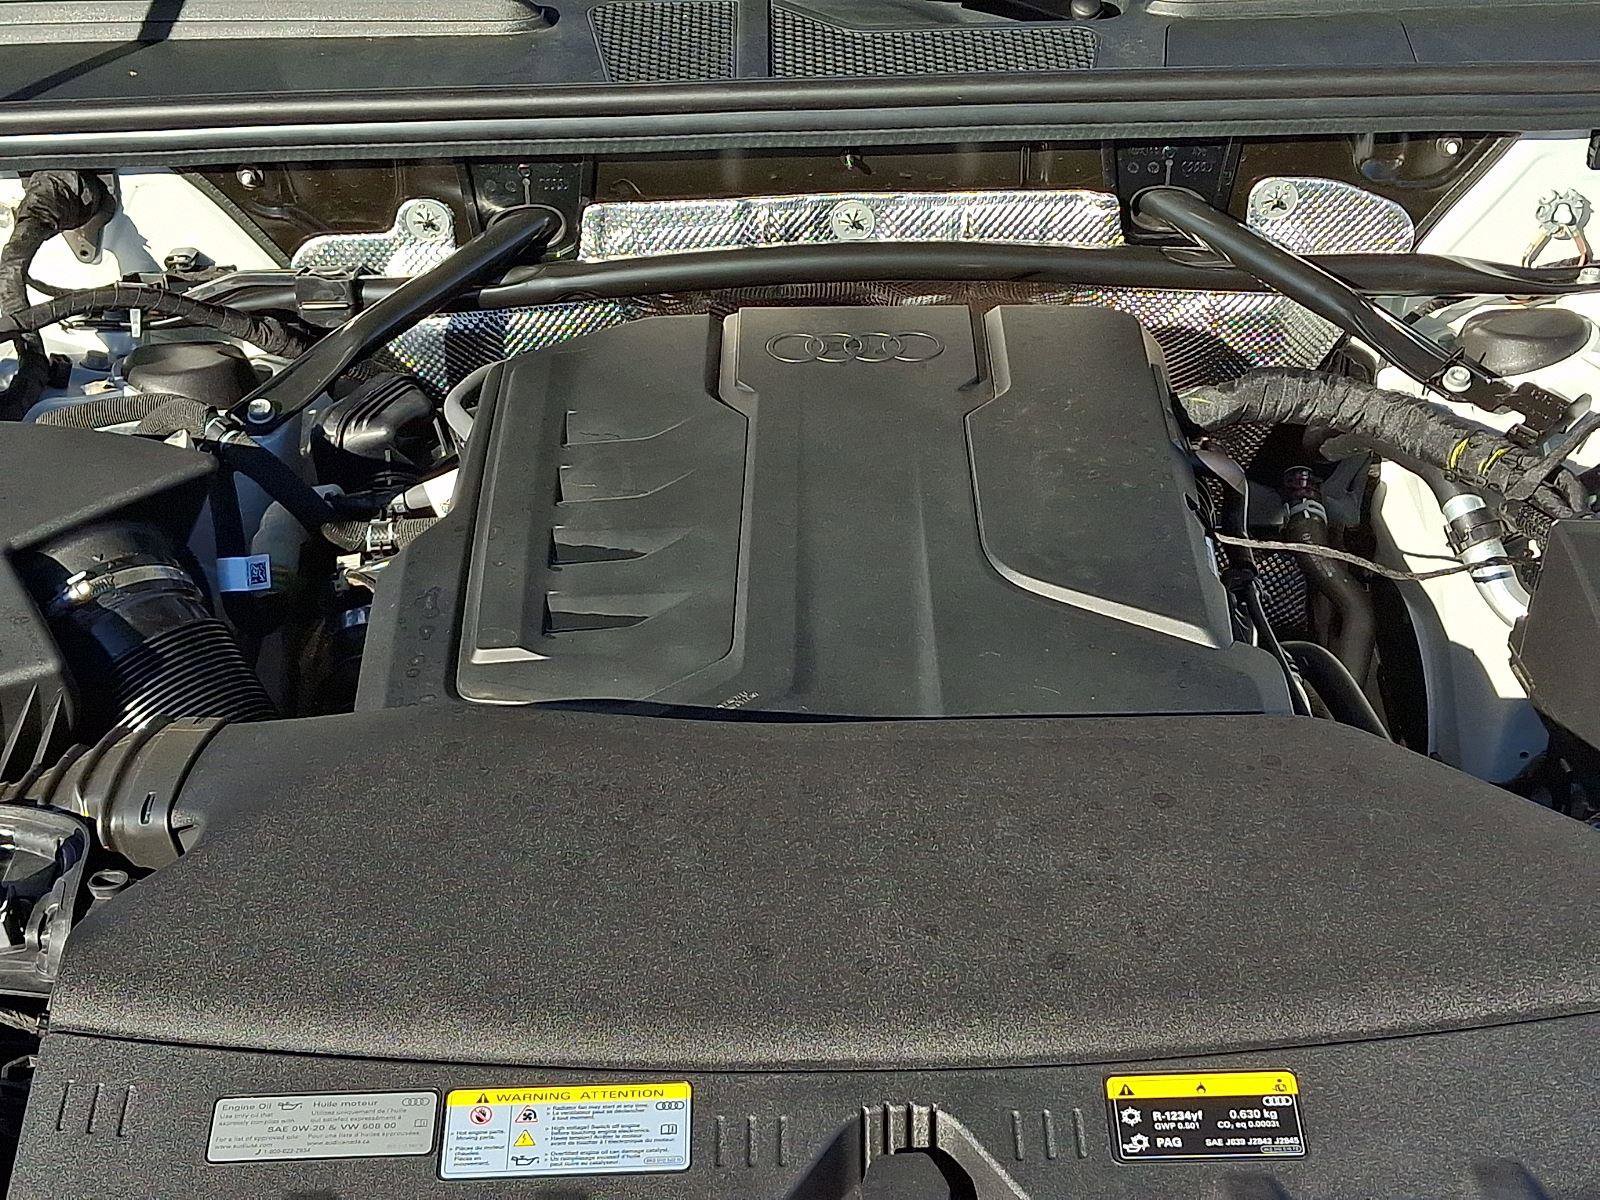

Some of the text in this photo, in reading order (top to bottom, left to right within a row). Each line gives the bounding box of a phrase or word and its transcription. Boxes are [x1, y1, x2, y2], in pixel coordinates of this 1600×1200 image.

[496, 1089, 664, 1102] WARNING ATTENTION
[258, 1102, 272, 1110] Oil
[1152, 1110, 1203, 1121] R-1234yf
[1229, 1108, 1278, 1120] 0.630 kg
[267, 1125, 289, 1133] SAE
[1154, 1122, 1176, 1130] GWP
[1235, 1122, 1247, 1130] eq
[1156, 1137, 1183, 1148] PAG
[1205, 1138, 1223, 1147] SAE
